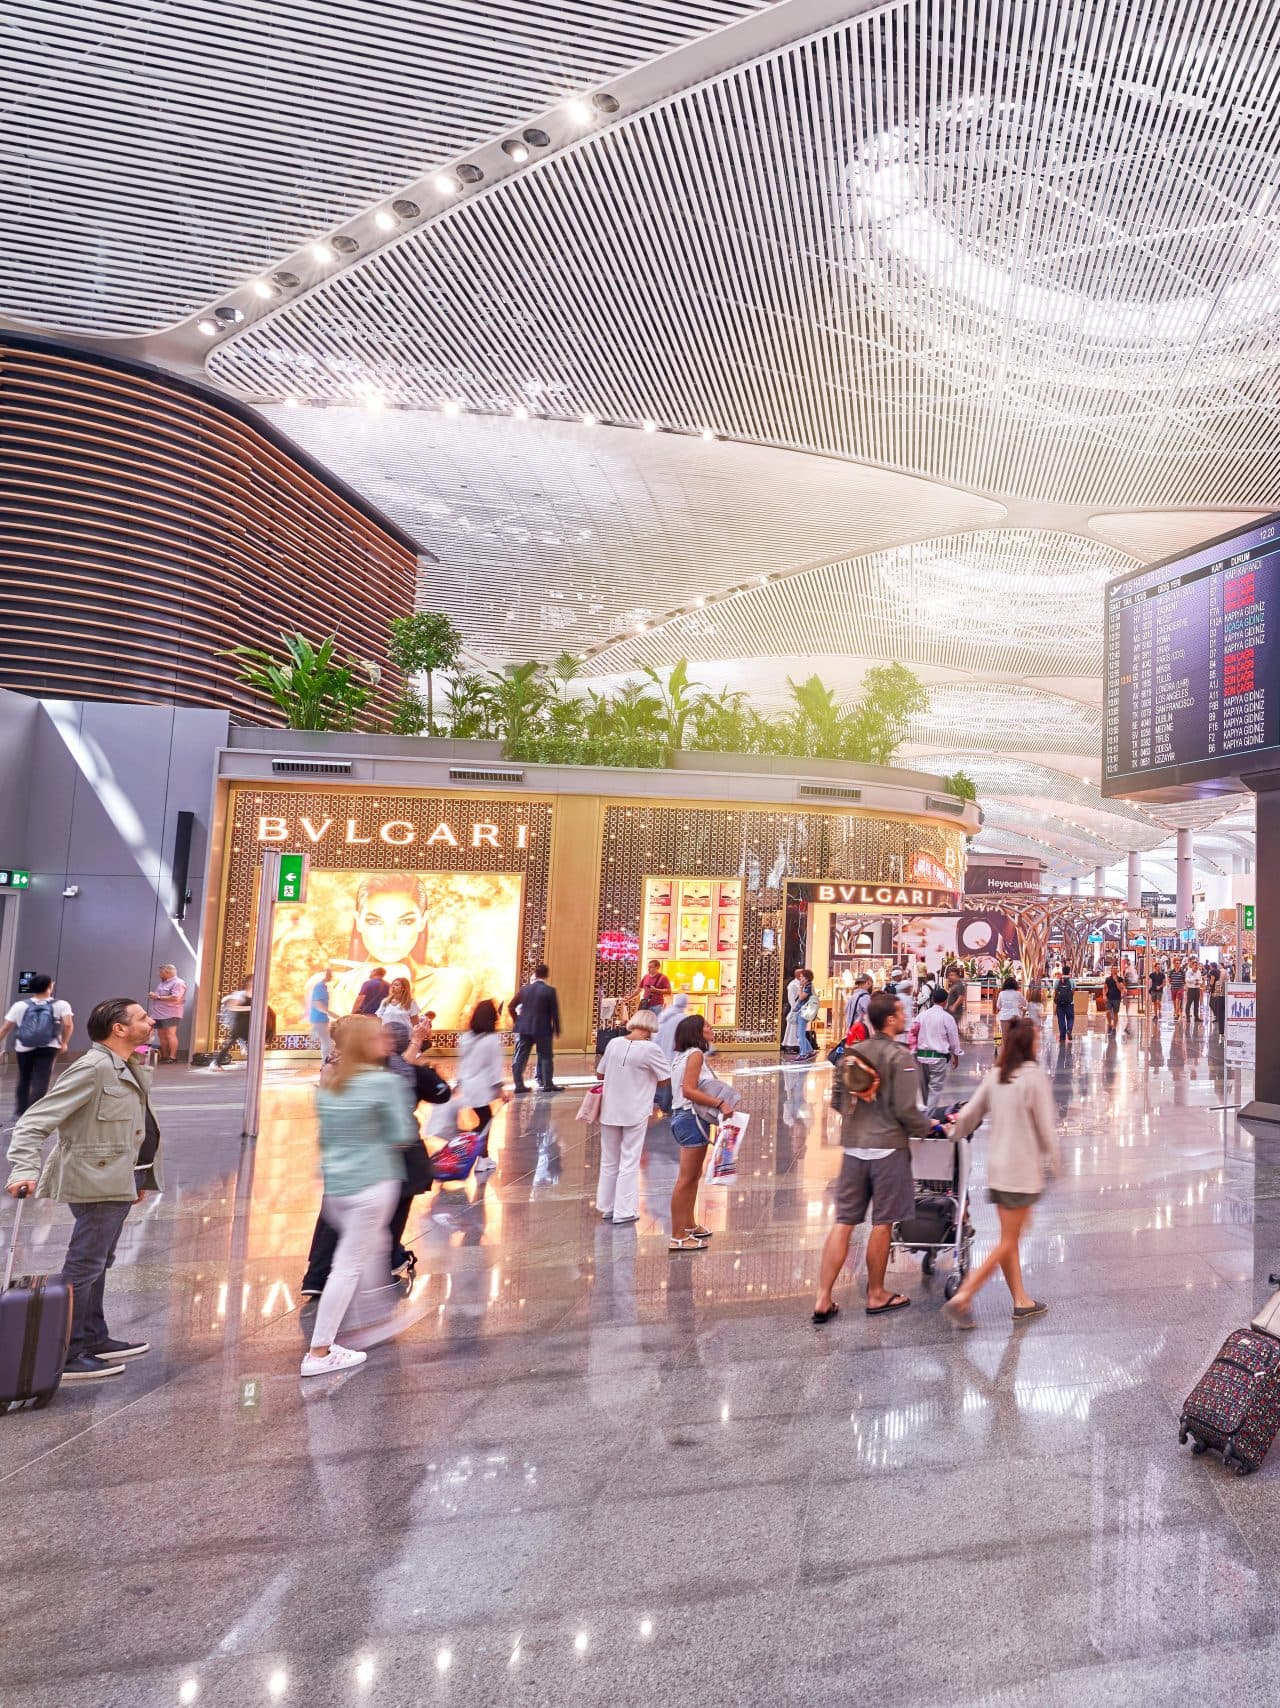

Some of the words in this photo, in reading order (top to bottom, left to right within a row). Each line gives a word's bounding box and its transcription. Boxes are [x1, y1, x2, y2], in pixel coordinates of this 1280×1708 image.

[257, 815, 527, 849] BVLGARI
[987, 878, 1022, 889] Heyecan
[819, 884, 932, 905] BVLGARI
